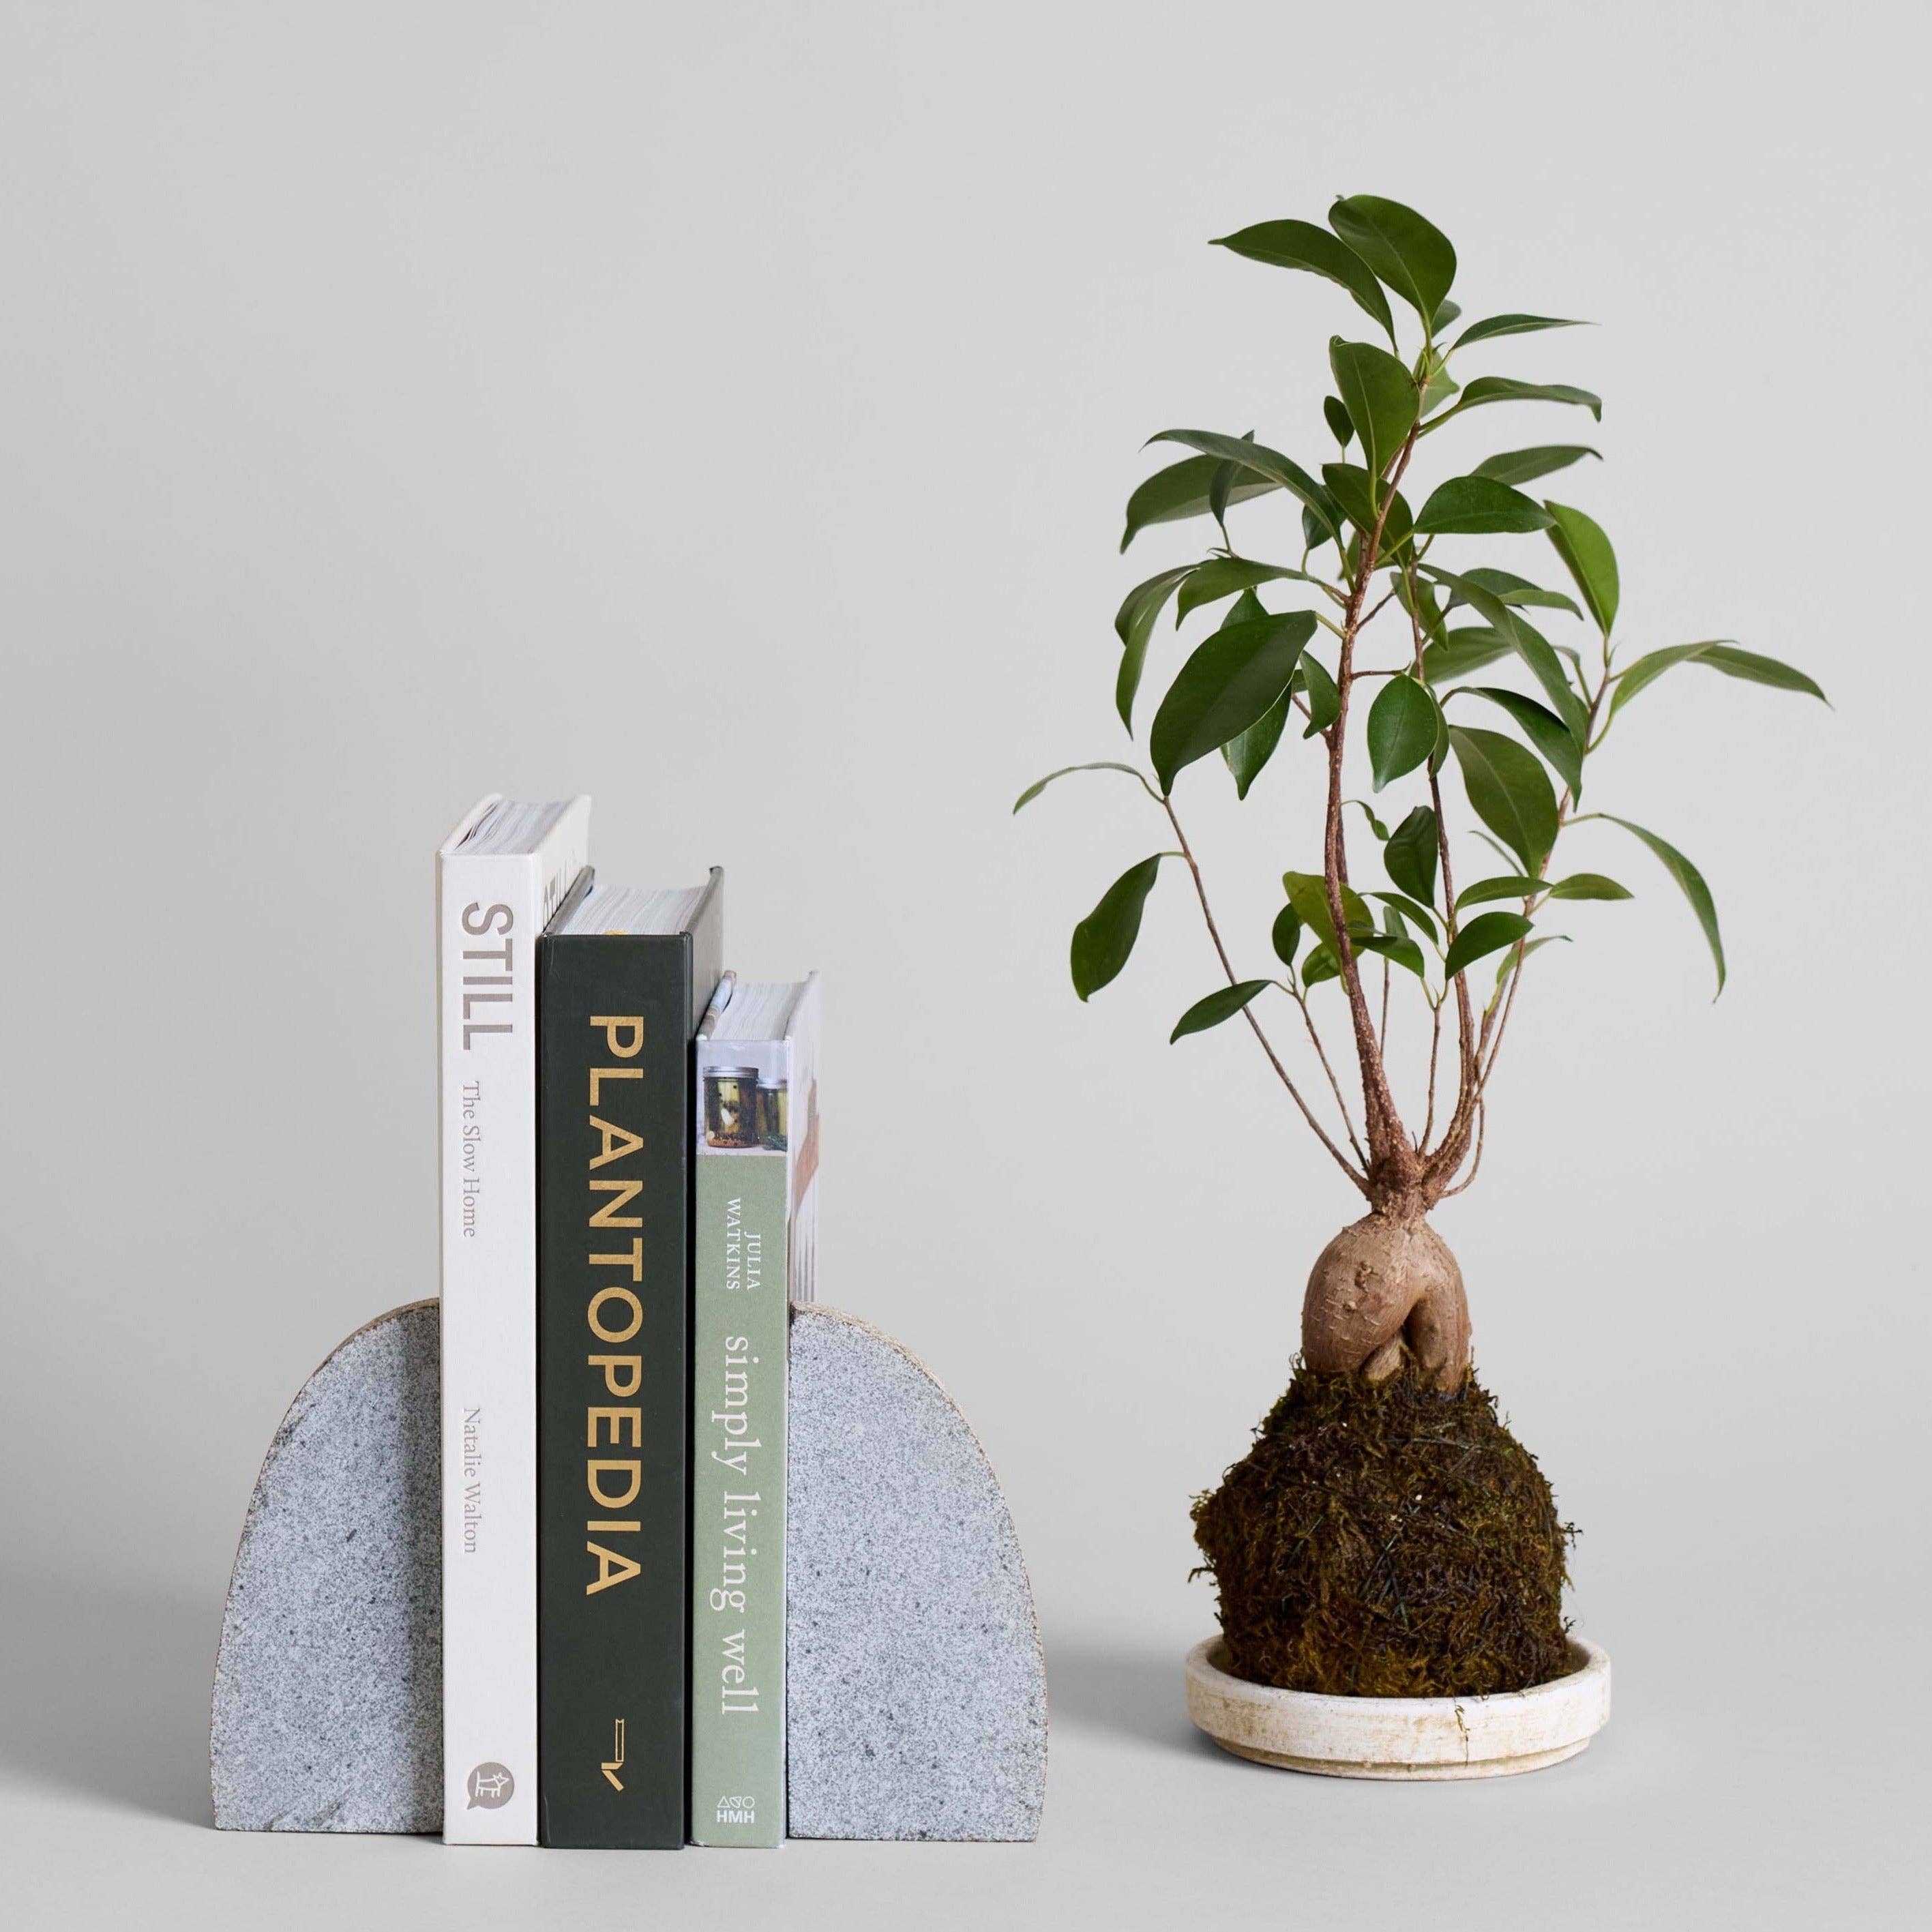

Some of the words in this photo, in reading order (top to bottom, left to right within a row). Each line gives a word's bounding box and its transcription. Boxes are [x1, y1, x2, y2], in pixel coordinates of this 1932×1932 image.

[462, 902, 514, 1051] STILL
[462, 1080, 480, 1119] The
[462, 1125, 481, 1172] Slow
[463, 1178, 480, 1238] Home
[726, 1198, 743, 1290] WATKINS
[745, 1231, 761, 1290] JULIA
[586, 1015, 644, 1596] PLANTOPEDIA
[711, 1336, 762, 1476] simply
[464, 1407, 481, 1477] Natalie
[464, 1483, 481, 1553] Walton
[709, 1491, 761, 1614] living
[722, 1629, 760, 1714] well
[716, 1809, 756, 1824] HMH
